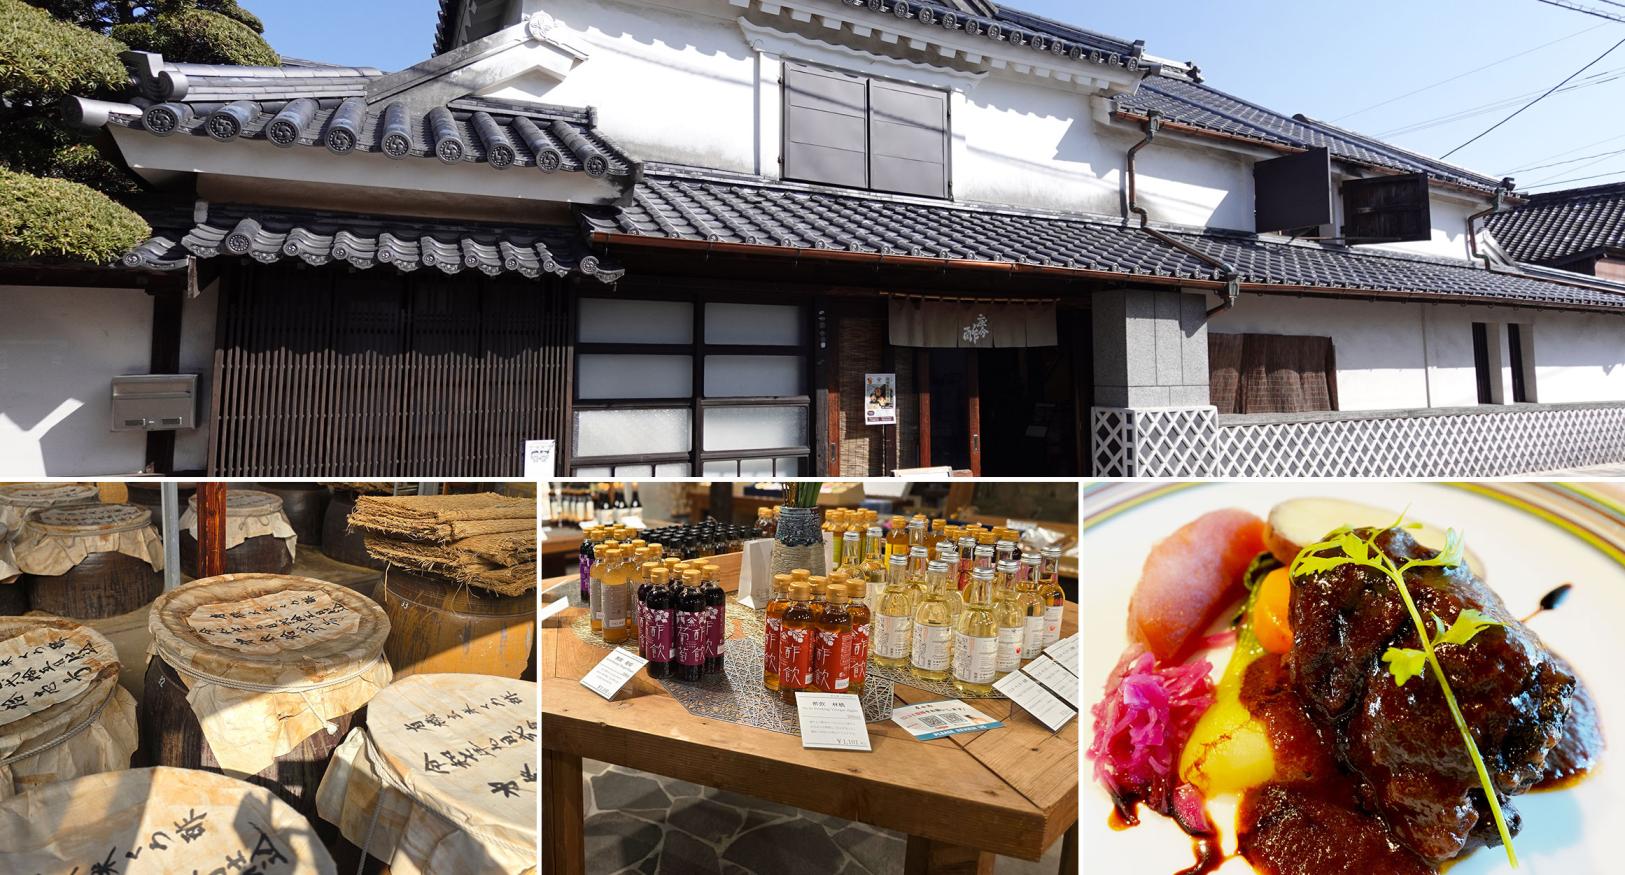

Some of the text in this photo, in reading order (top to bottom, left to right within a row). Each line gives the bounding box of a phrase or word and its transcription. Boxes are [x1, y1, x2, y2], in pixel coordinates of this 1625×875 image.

[784, 643, 802, 687] 酢飲
[71, 808, 207, 875] 米くろ酢
